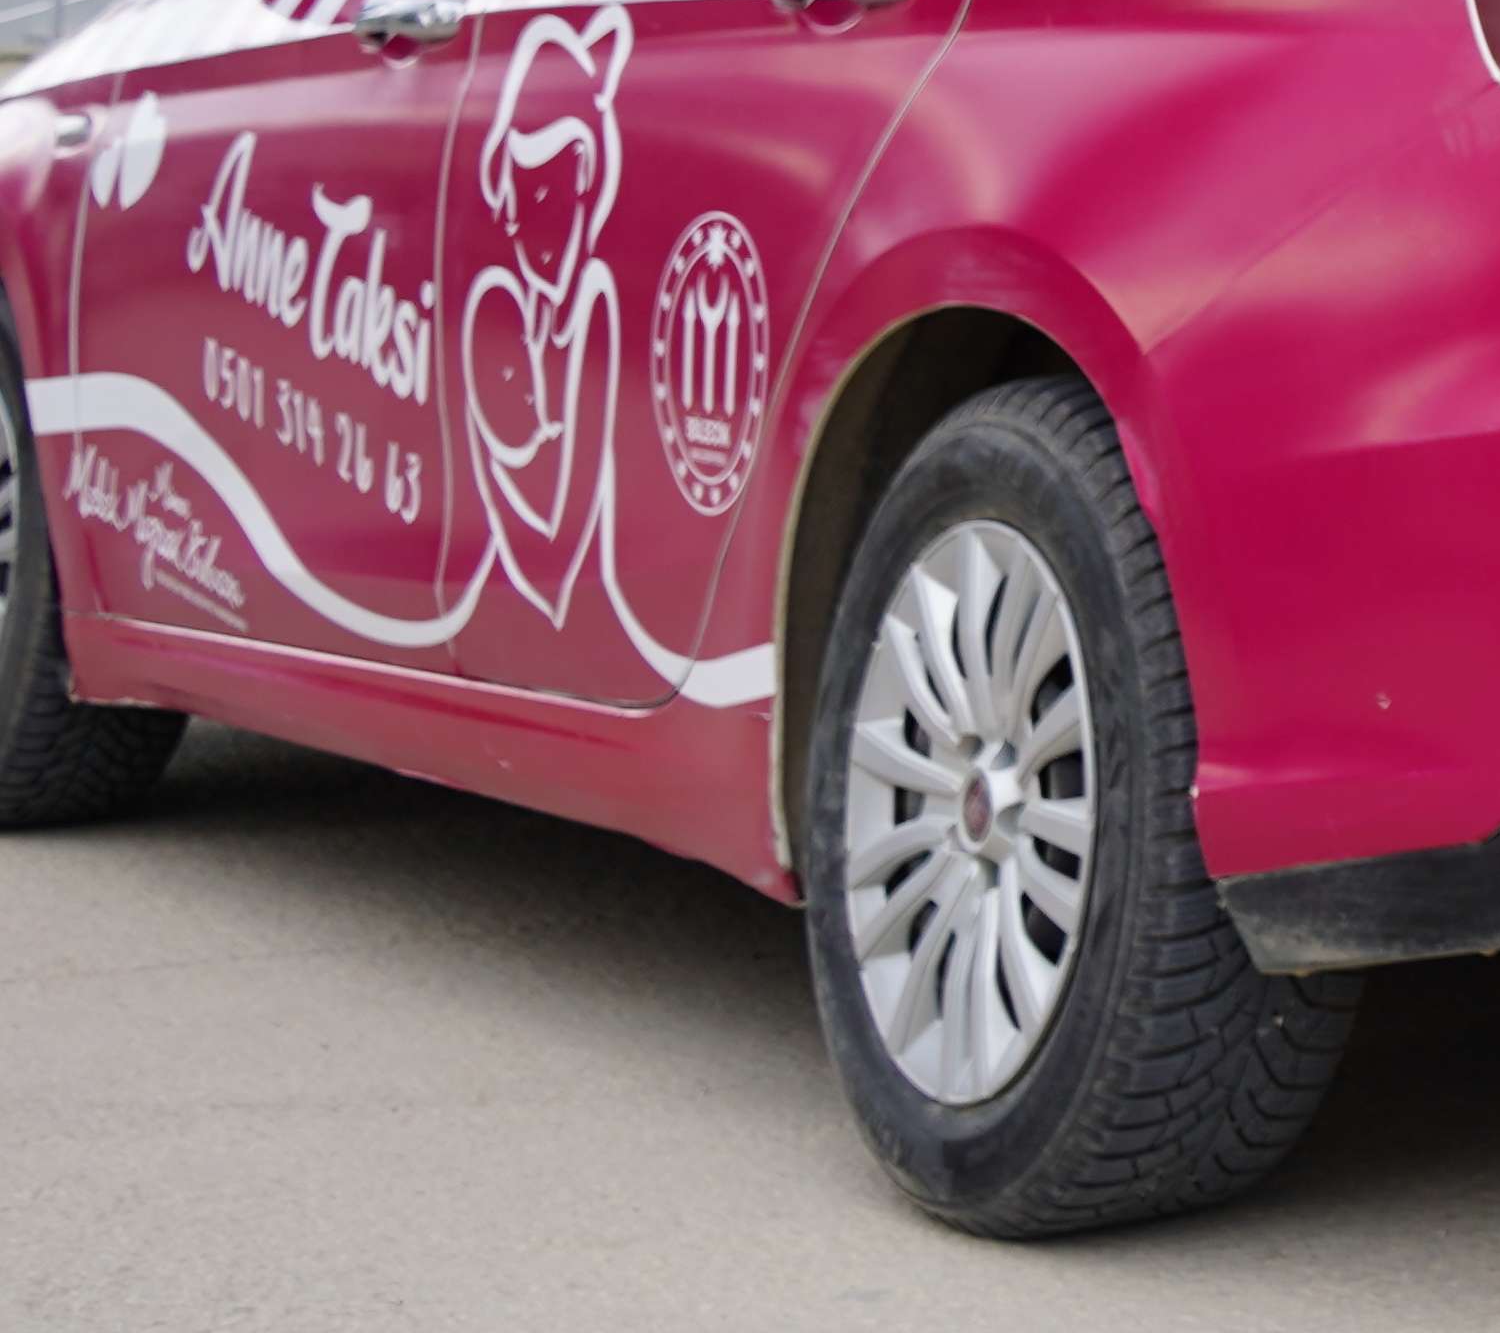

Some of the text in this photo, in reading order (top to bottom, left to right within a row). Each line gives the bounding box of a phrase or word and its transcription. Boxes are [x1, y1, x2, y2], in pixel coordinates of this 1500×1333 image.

[186, 130, 437, 407] Anne Taksi
[203, 335, 423, 525] 0501 314 26 63
